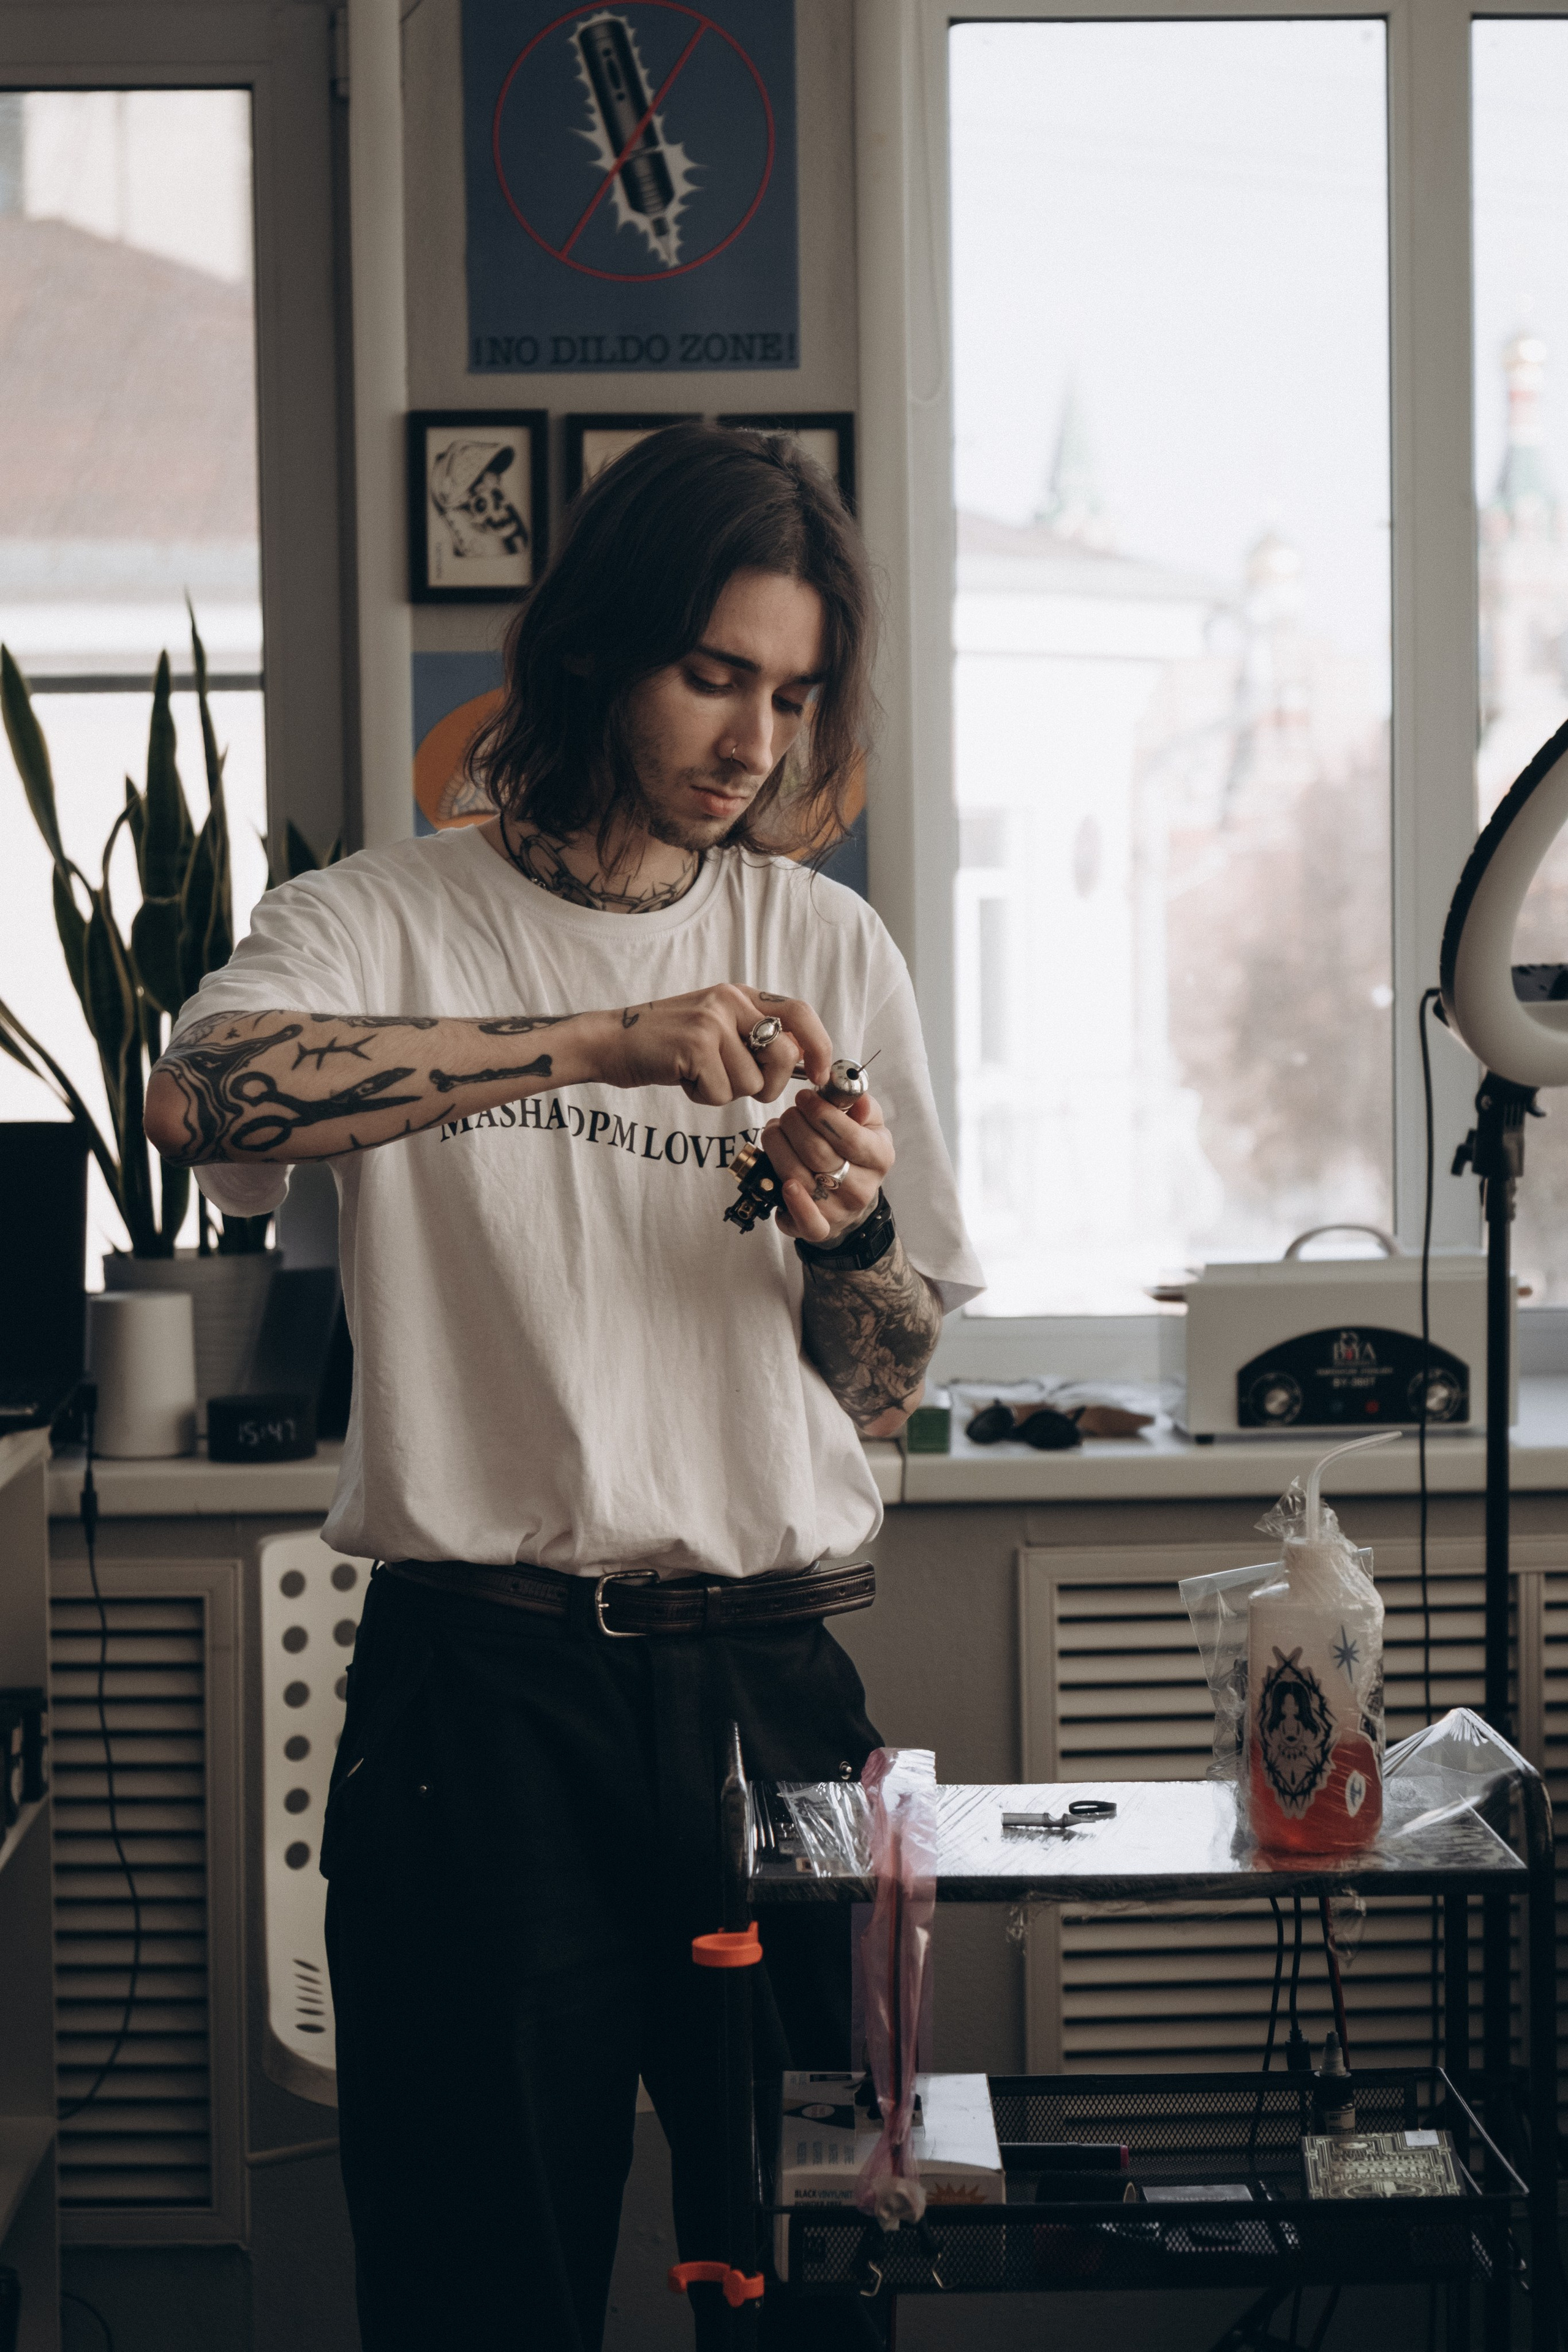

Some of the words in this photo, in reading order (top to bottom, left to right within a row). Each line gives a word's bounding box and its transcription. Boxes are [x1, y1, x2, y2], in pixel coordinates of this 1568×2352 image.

[550, 334, 669, 366] DILDO
[679, 331, 796, 363] ZONE!
[794, 2189, 816, 2198] BLACK
